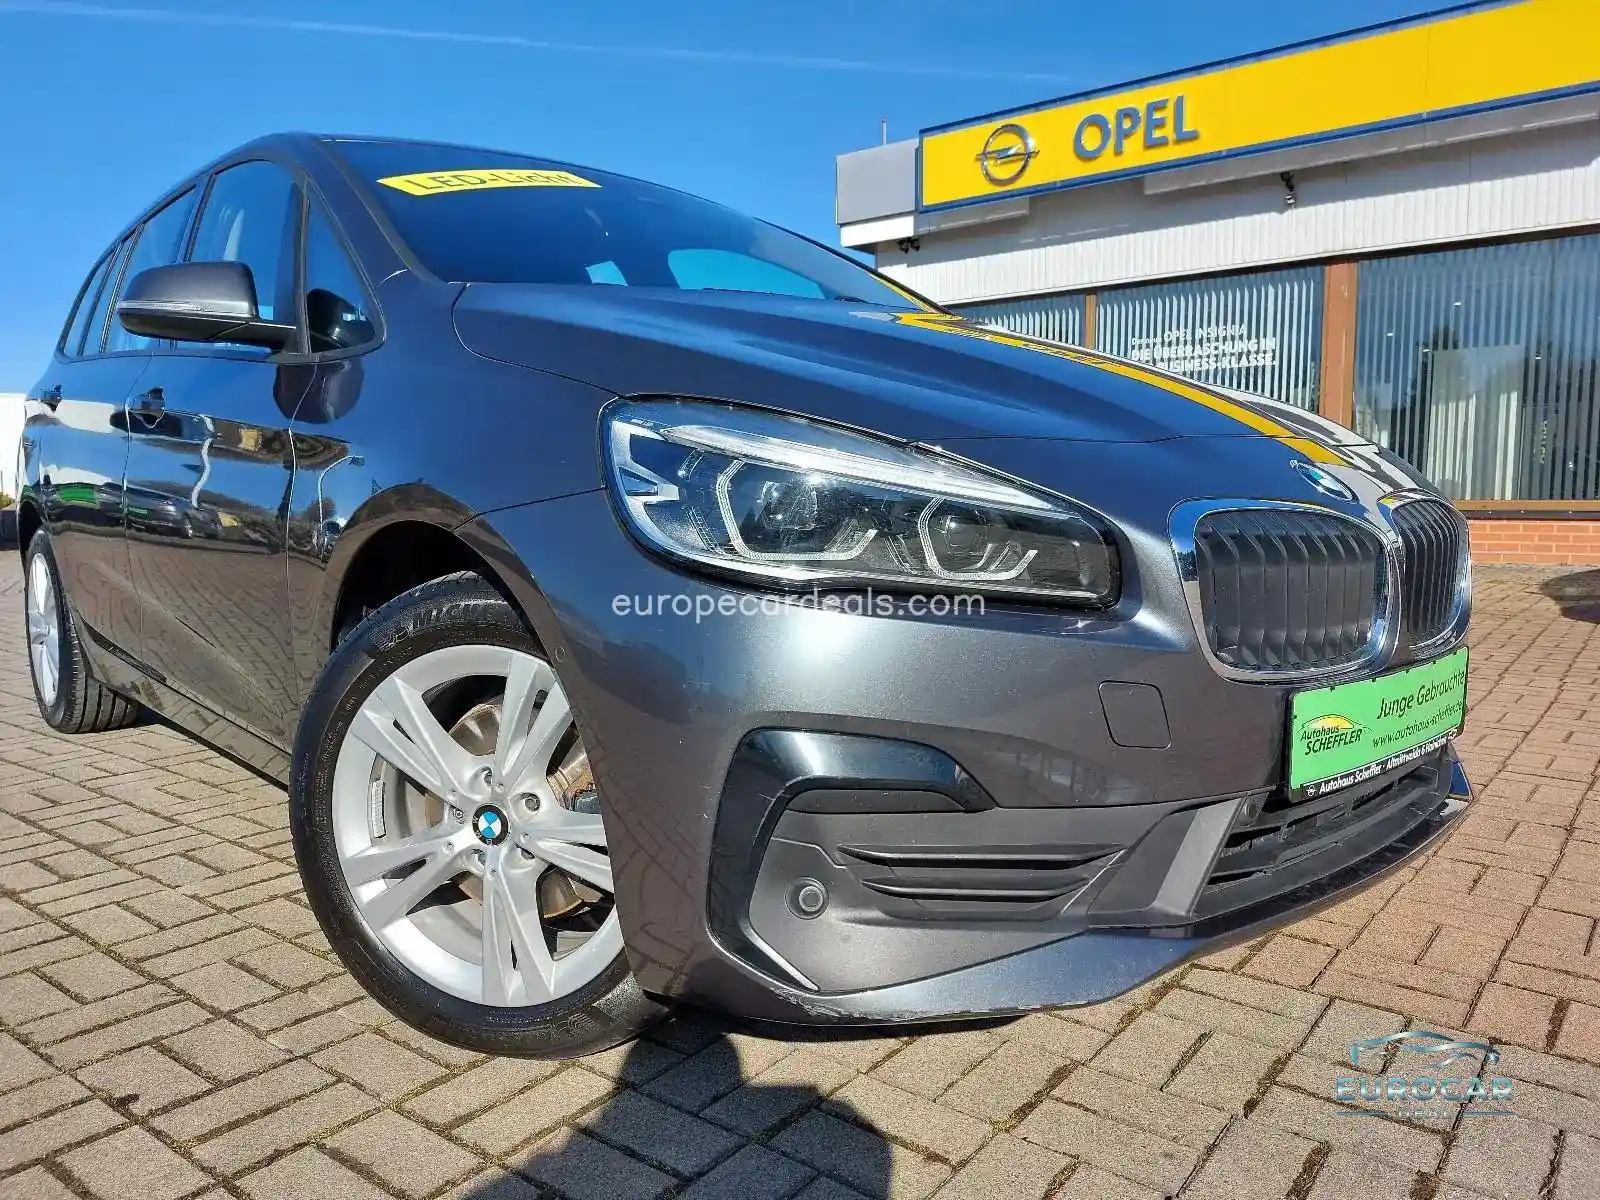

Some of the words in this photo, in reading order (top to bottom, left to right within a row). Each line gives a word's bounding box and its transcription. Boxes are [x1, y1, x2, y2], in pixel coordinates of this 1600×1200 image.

[1073, 95, 1200, 161] OPEL
[403, 172, 582, 190] LED-Licht
[1164, 328, 1192, 342] OPEL
[1195, 324, 1248, 340] INSIGNIA
[1154, 339, 1258, 359] ÜBERRASCHUNG
[1259, 337, 1275, 352] IN
[1377, 697, 1414, 719] Junge
[1416, 669, 1465, 705] Gebrauchte
[1300, 725, 1340, 742] Autohaus
[1304, 728, 1362, 755] SCHEFFLER
[1319, 773, 1354, 794] Autohaus
[1354, 762, 1382, 783] Scheffler
